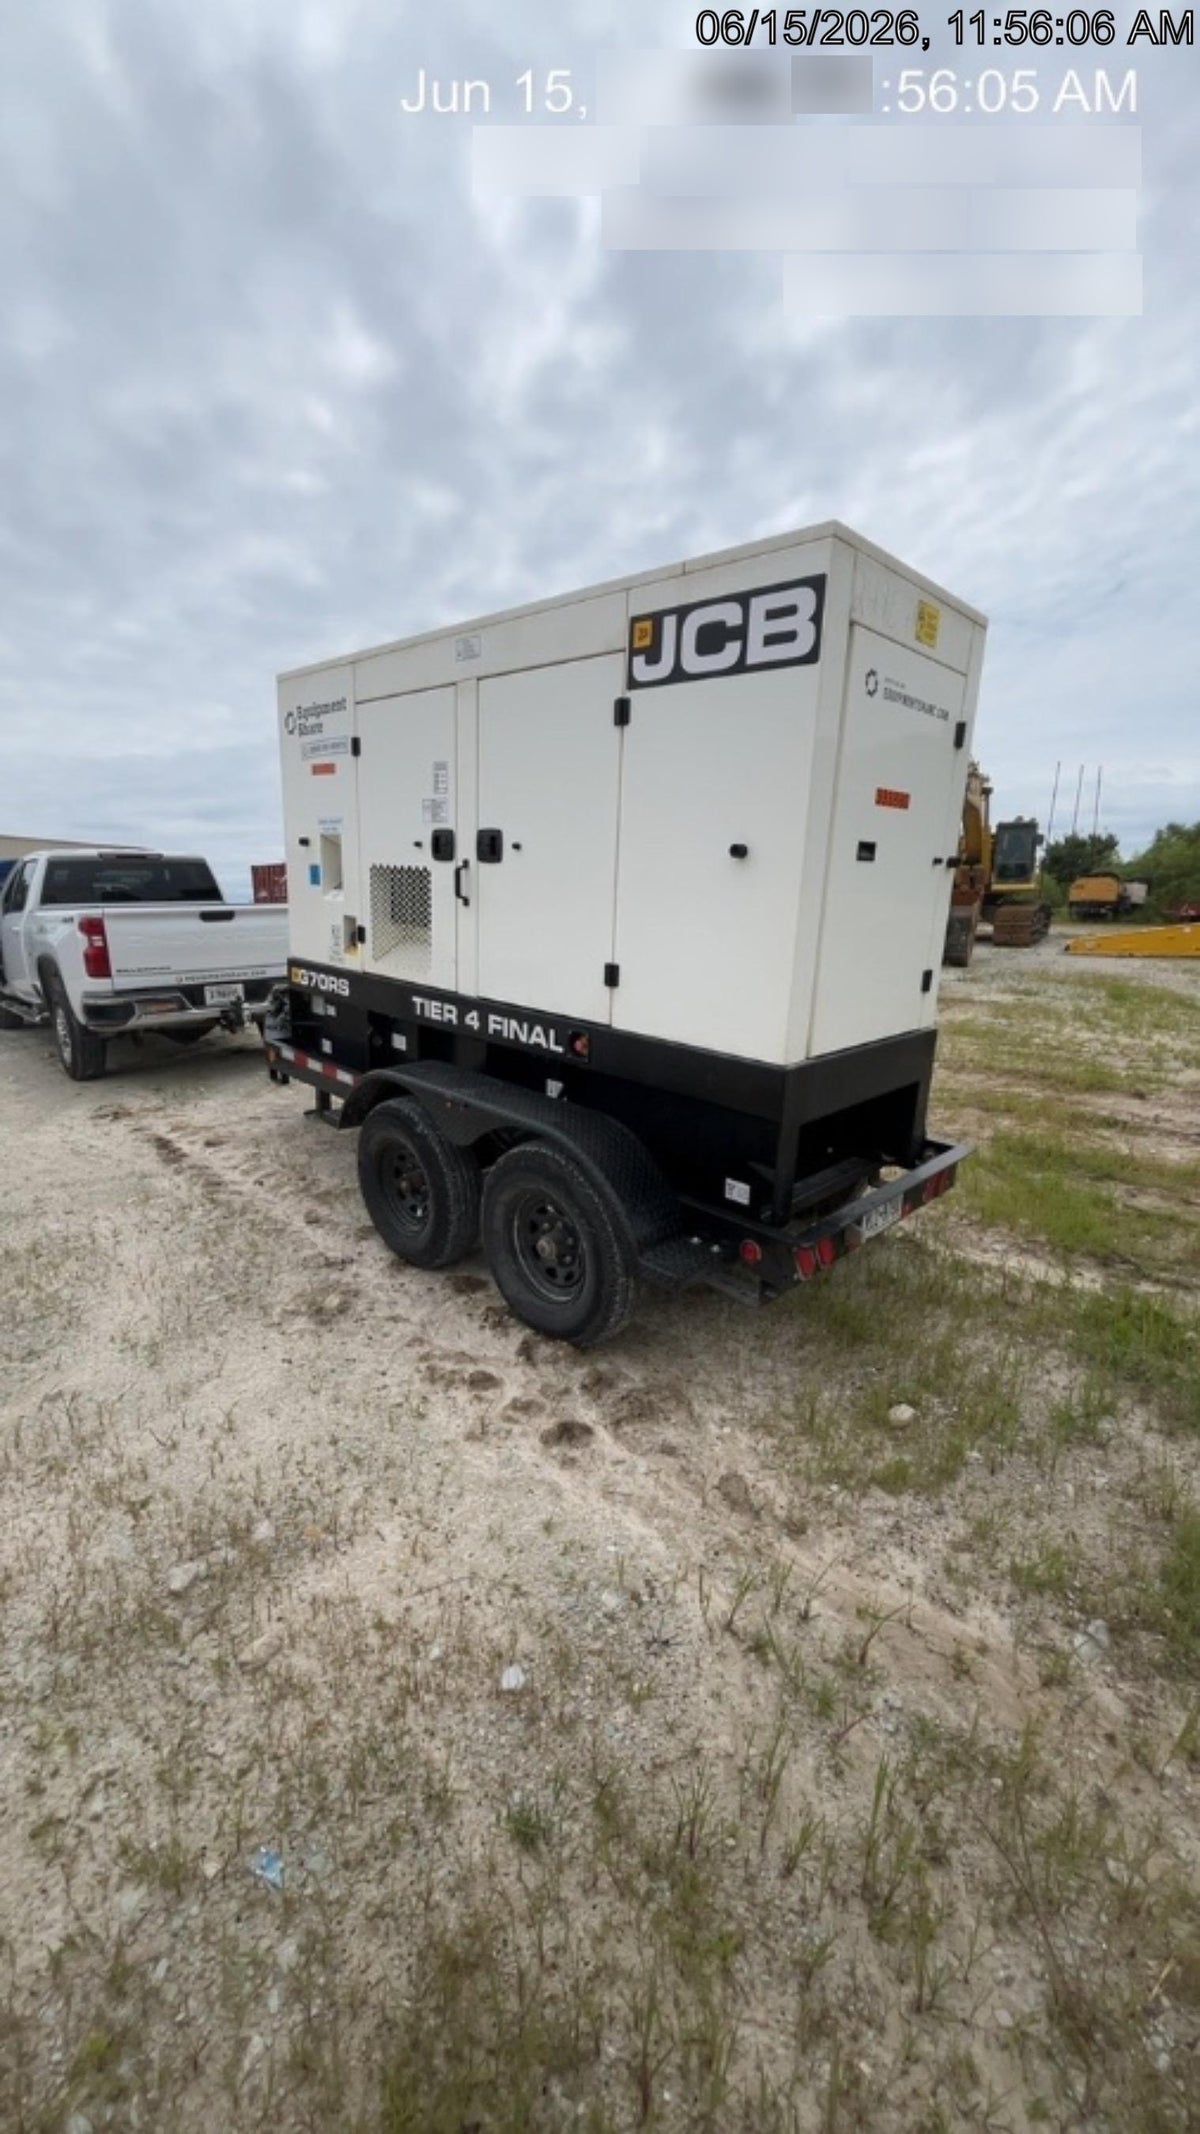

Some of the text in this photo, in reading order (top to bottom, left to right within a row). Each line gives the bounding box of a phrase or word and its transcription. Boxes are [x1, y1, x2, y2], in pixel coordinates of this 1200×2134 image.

[632, 586, 818, 682] JCB
[412, 995, 565, 1054] TIER 4 FINAL
